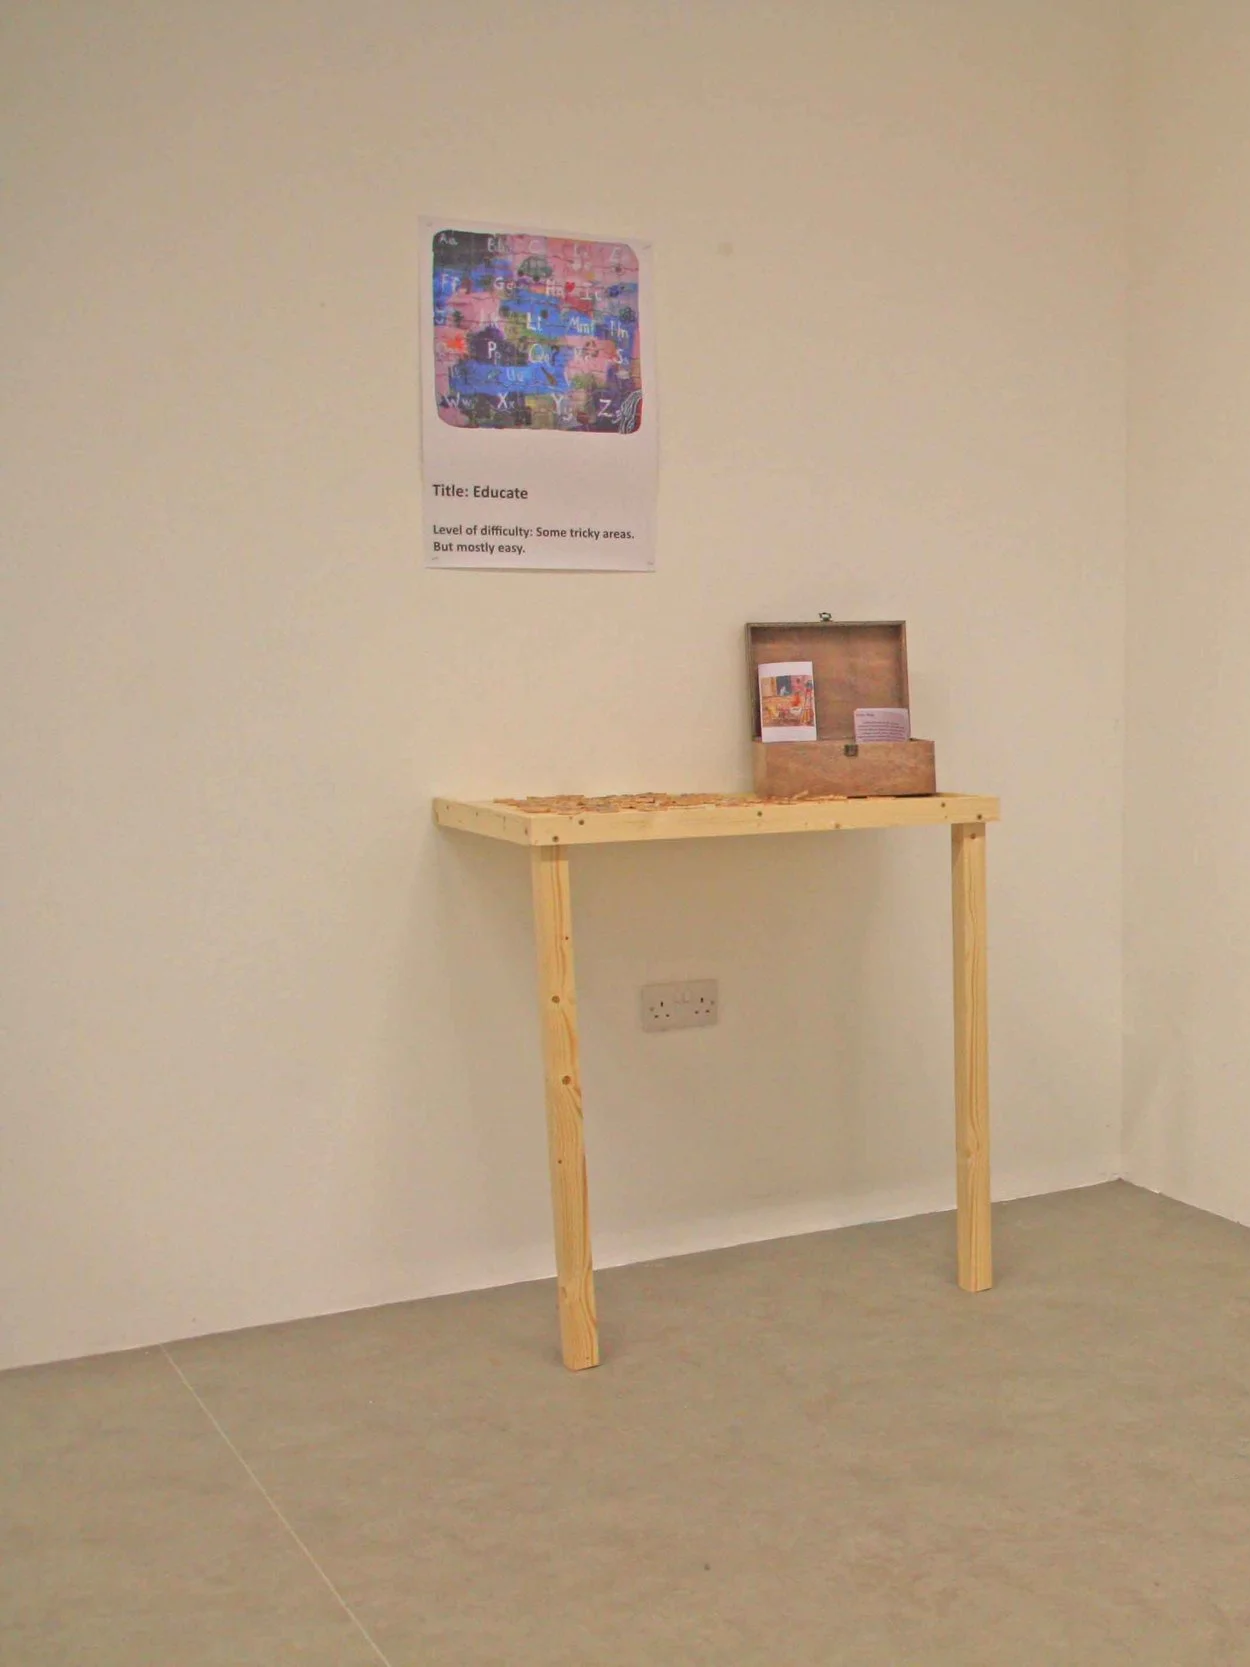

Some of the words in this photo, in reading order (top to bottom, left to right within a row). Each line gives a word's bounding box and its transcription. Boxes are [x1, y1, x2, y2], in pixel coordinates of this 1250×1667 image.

[432, 484, 469, 497] Title:
[474, 485, 528, 499] Educate
[433, 525, 462, 535] Level
[466, 525, 477, 536] of
[480, 526, 533, 538] difficulty:
[536, 527, 567, 537] Some
[570, 528, 600, 540] tricky
[603, 530, 635, 539] areas.
[434, 542, 453, 551] But
[457, 543, 495, 554] mostly
[498, 545, 526, 555] easy.
